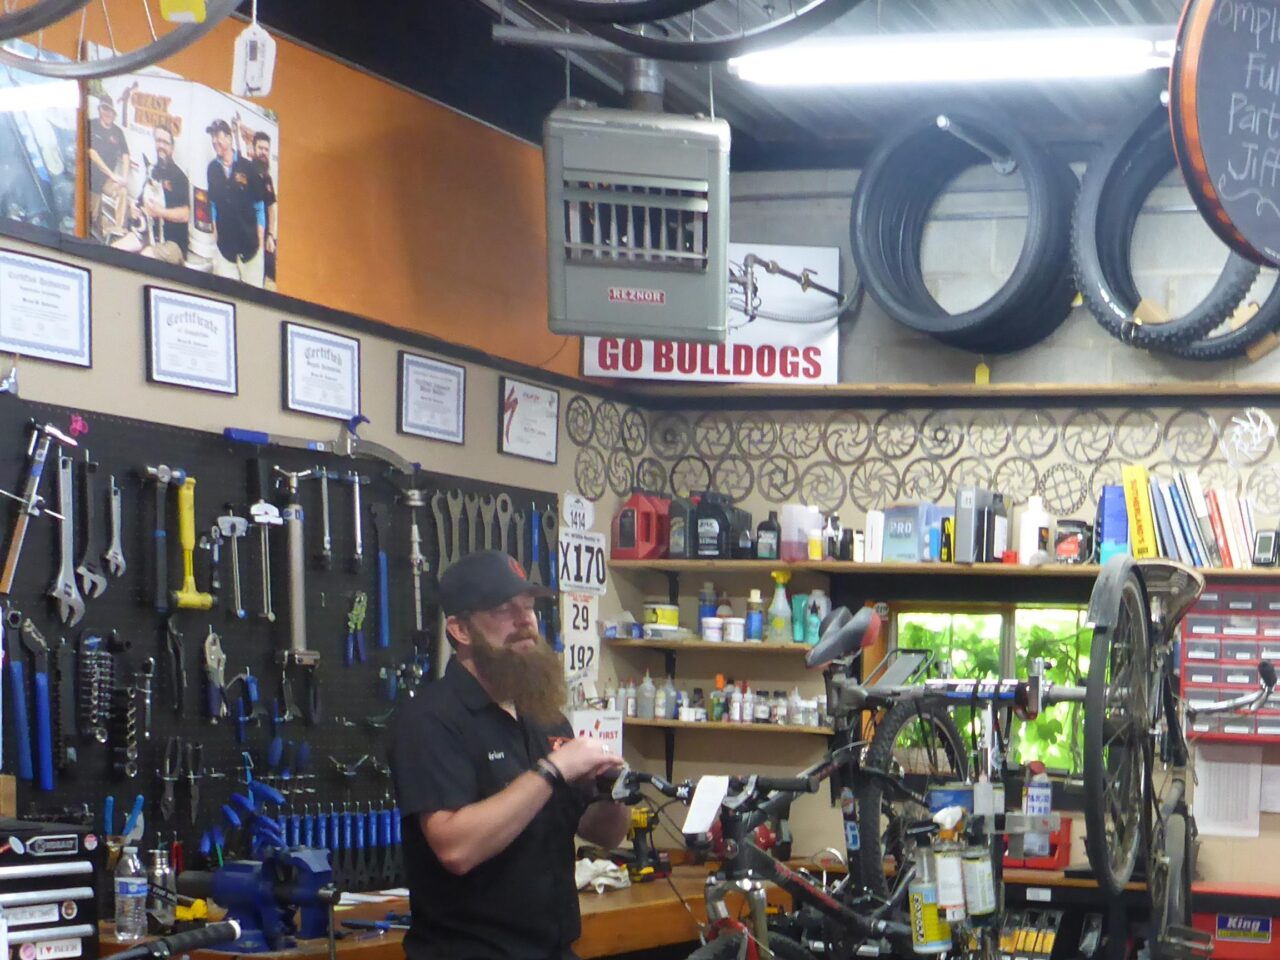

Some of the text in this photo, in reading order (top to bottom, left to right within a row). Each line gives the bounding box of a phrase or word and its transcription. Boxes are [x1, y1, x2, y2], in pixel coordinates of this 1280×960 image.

[612, 288, 664, 303] REZNOR
[167, 311, 219, 335] Certificate
[598, 337, 822, 379] GO BULLDOGS
[559, 540, 606, 585] X170
[572, 603, 590, 631] 29
[1225, 916, 1261, 932] King
